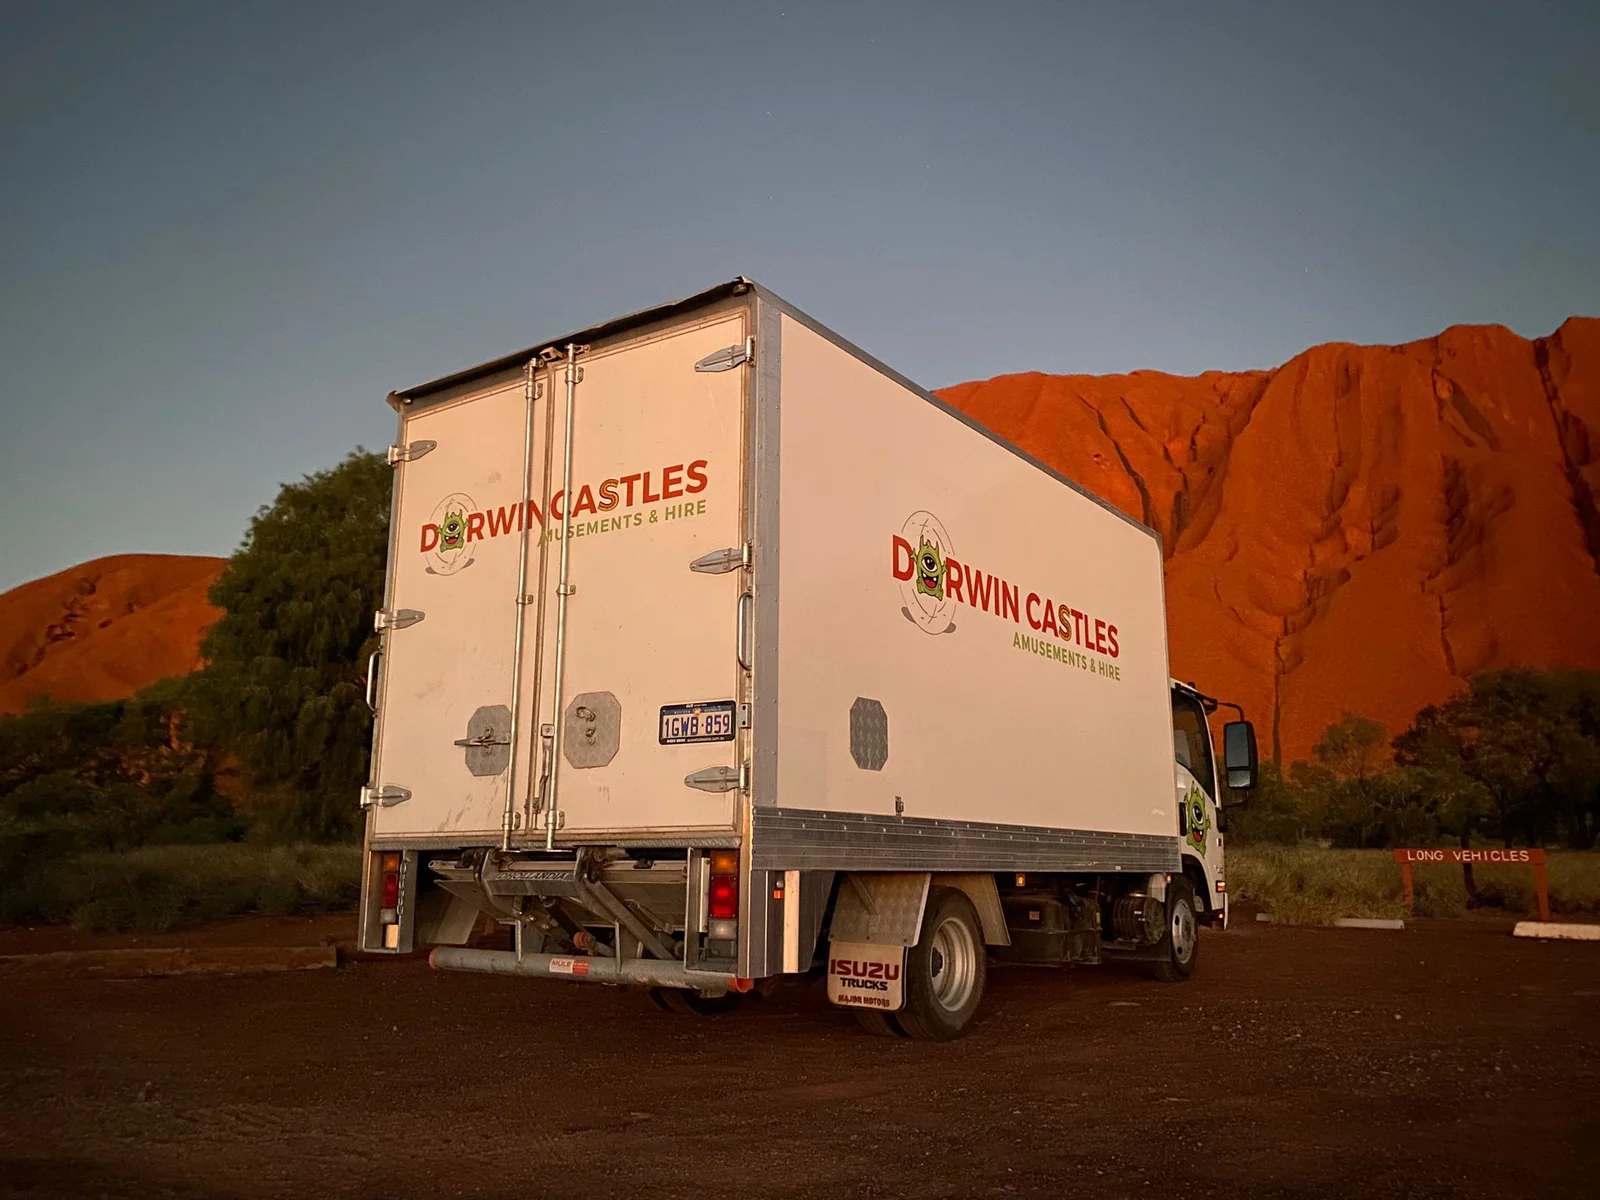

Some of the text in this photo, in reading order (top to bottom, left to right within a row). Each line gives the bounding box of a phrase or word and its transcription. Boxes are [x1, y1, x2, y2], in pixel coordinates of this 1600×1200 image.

[550, 460, 709, 520] CASTLES
[537, 499, 707, 547] AMUSEMENTS & HIRE
[1026, 592, 1120, 658] CASTLES
[1012, 631, 1121, 681] AMUSEMENTS & HIRE
[1407, 849, 1530, 862] LONG VEHICLES
[830, 959, 899, 981] ISUZU
[840, 977, 888, 991] TRUCKS
[838, 994, 890, 1008] MAJOR MOTORS
